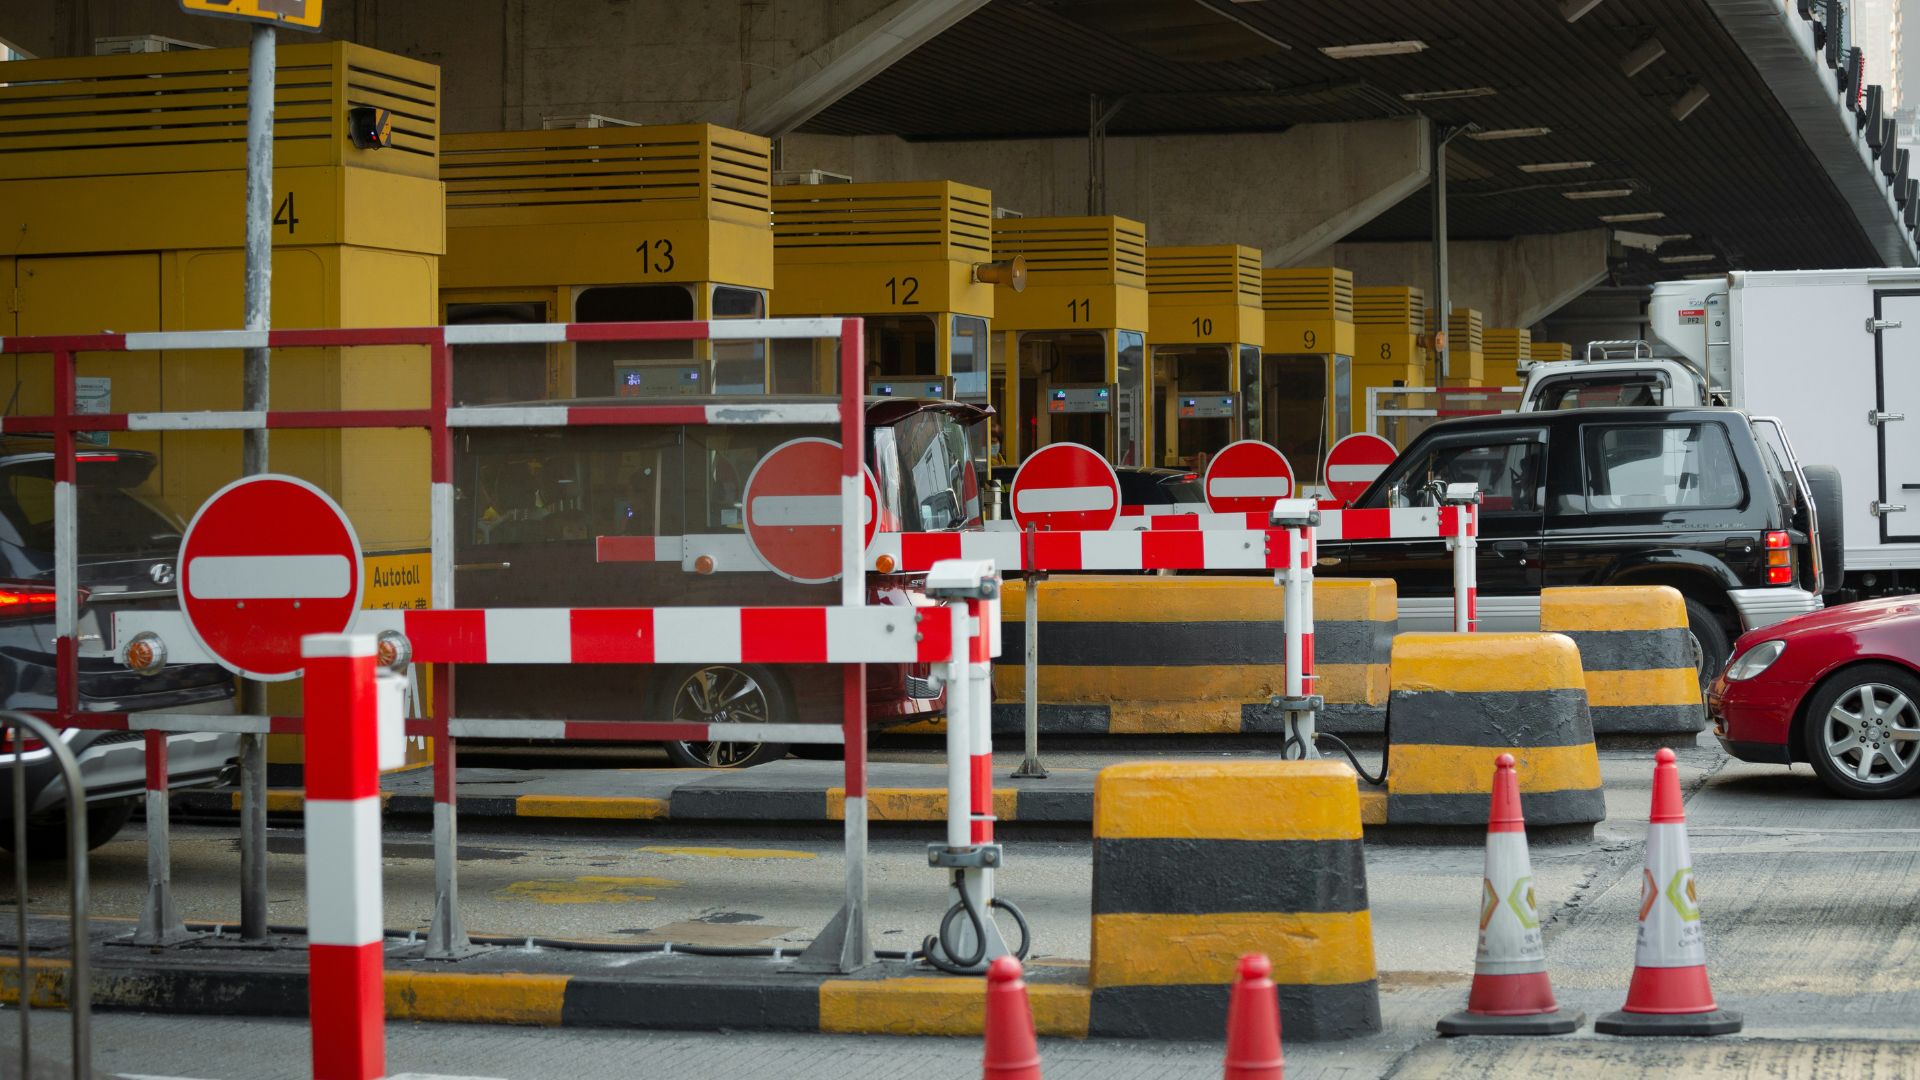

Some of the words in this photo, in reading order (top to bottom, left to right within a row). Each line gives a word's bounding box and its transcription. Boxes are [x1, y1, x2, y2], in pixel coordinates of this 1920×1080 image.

[636, 239, 675, 274] 13
[885, 276, 920, 306] 12
[1067, 298, 1090, 323] 11
[1191, 316, 1213, 338] 10
[1303, 330, 1316, 350] 9
[1380, 342, 1392, 361] 8
[373, 565, 419, 588] Autotoll
